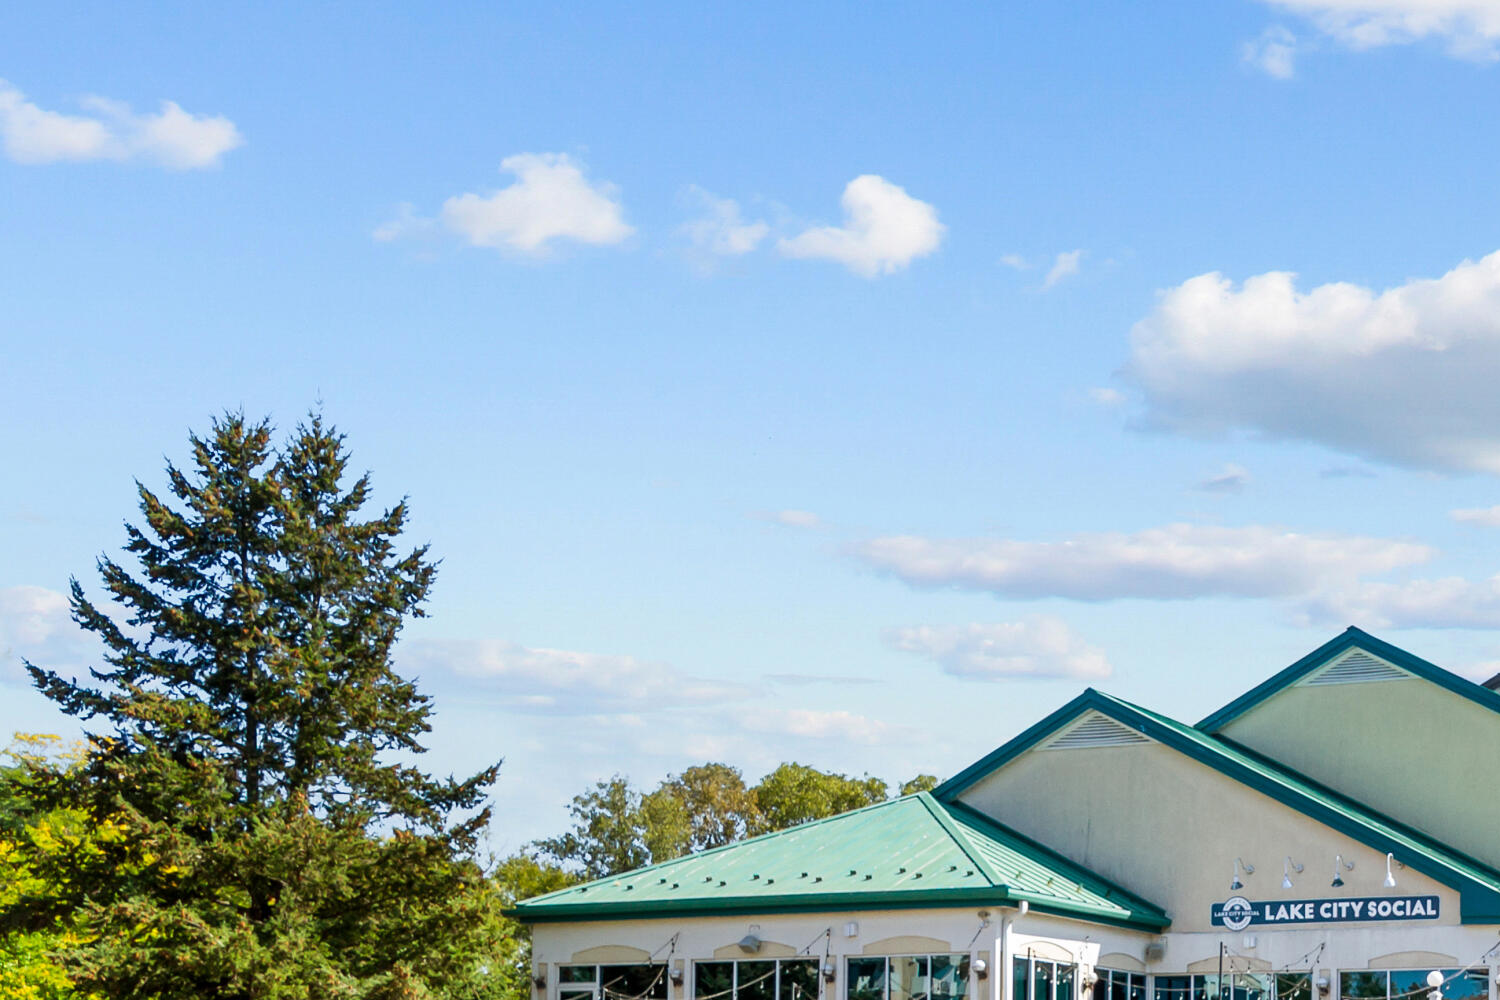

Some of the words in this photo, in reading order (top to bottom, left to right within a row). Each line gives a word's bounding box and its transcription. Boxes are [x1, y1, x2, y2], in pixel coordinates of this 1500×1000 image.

[1265, 903, 1314, 920] LAKE
[1320, 901, 1363, 919] CITY
[1368, 899, 1437, 917] SOCIAL
